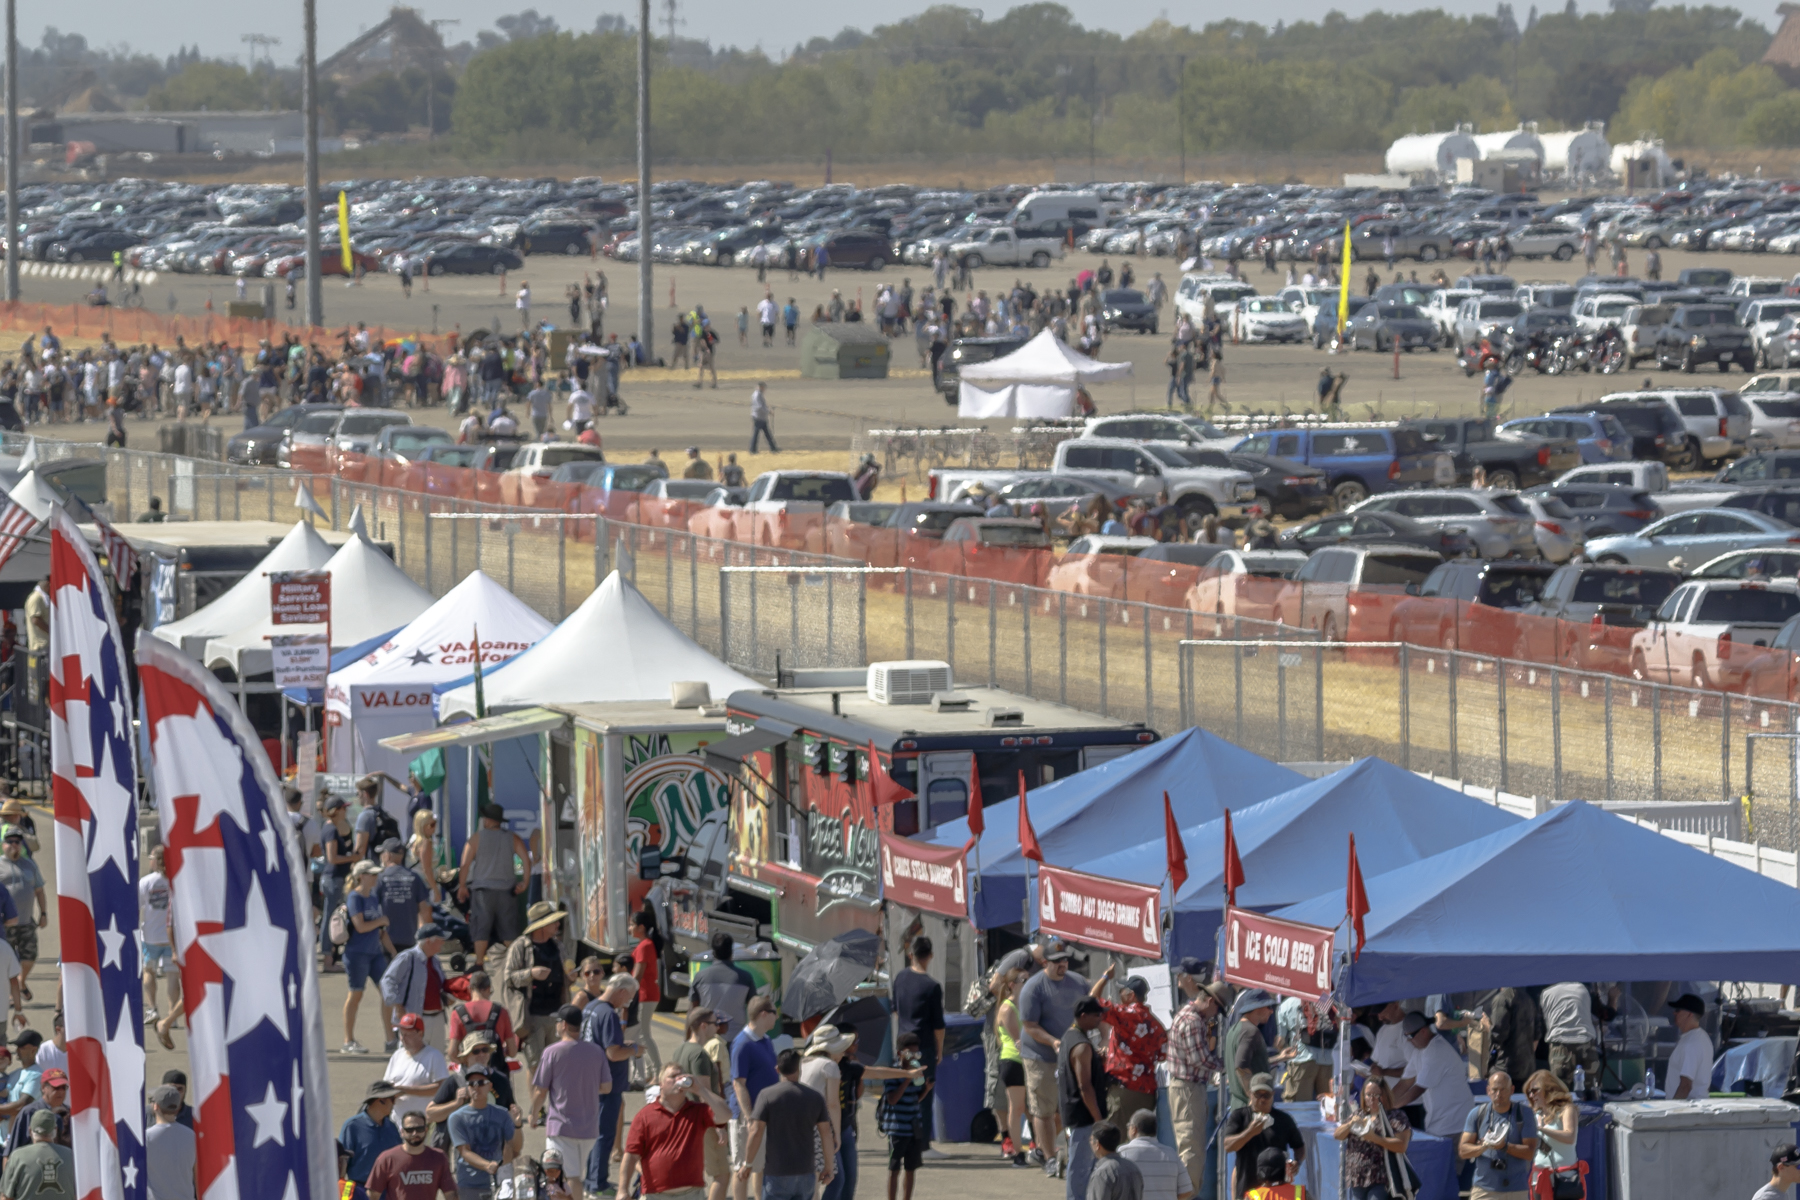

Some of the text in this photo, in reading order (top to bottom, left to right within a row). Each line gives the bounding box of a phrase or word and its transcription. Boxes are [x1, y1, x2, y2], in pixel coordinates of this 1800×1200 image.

[273, 602, 328, 613] Home Loan
[1060, 890, 1083, 914] JUMBO
[1245, 930, 1262, 961] ICE
[1264, 934, 1290, 968] COLD
[1290, 940, 1315, 975] BEER
[399, 1170, 434, 1186] VANS
